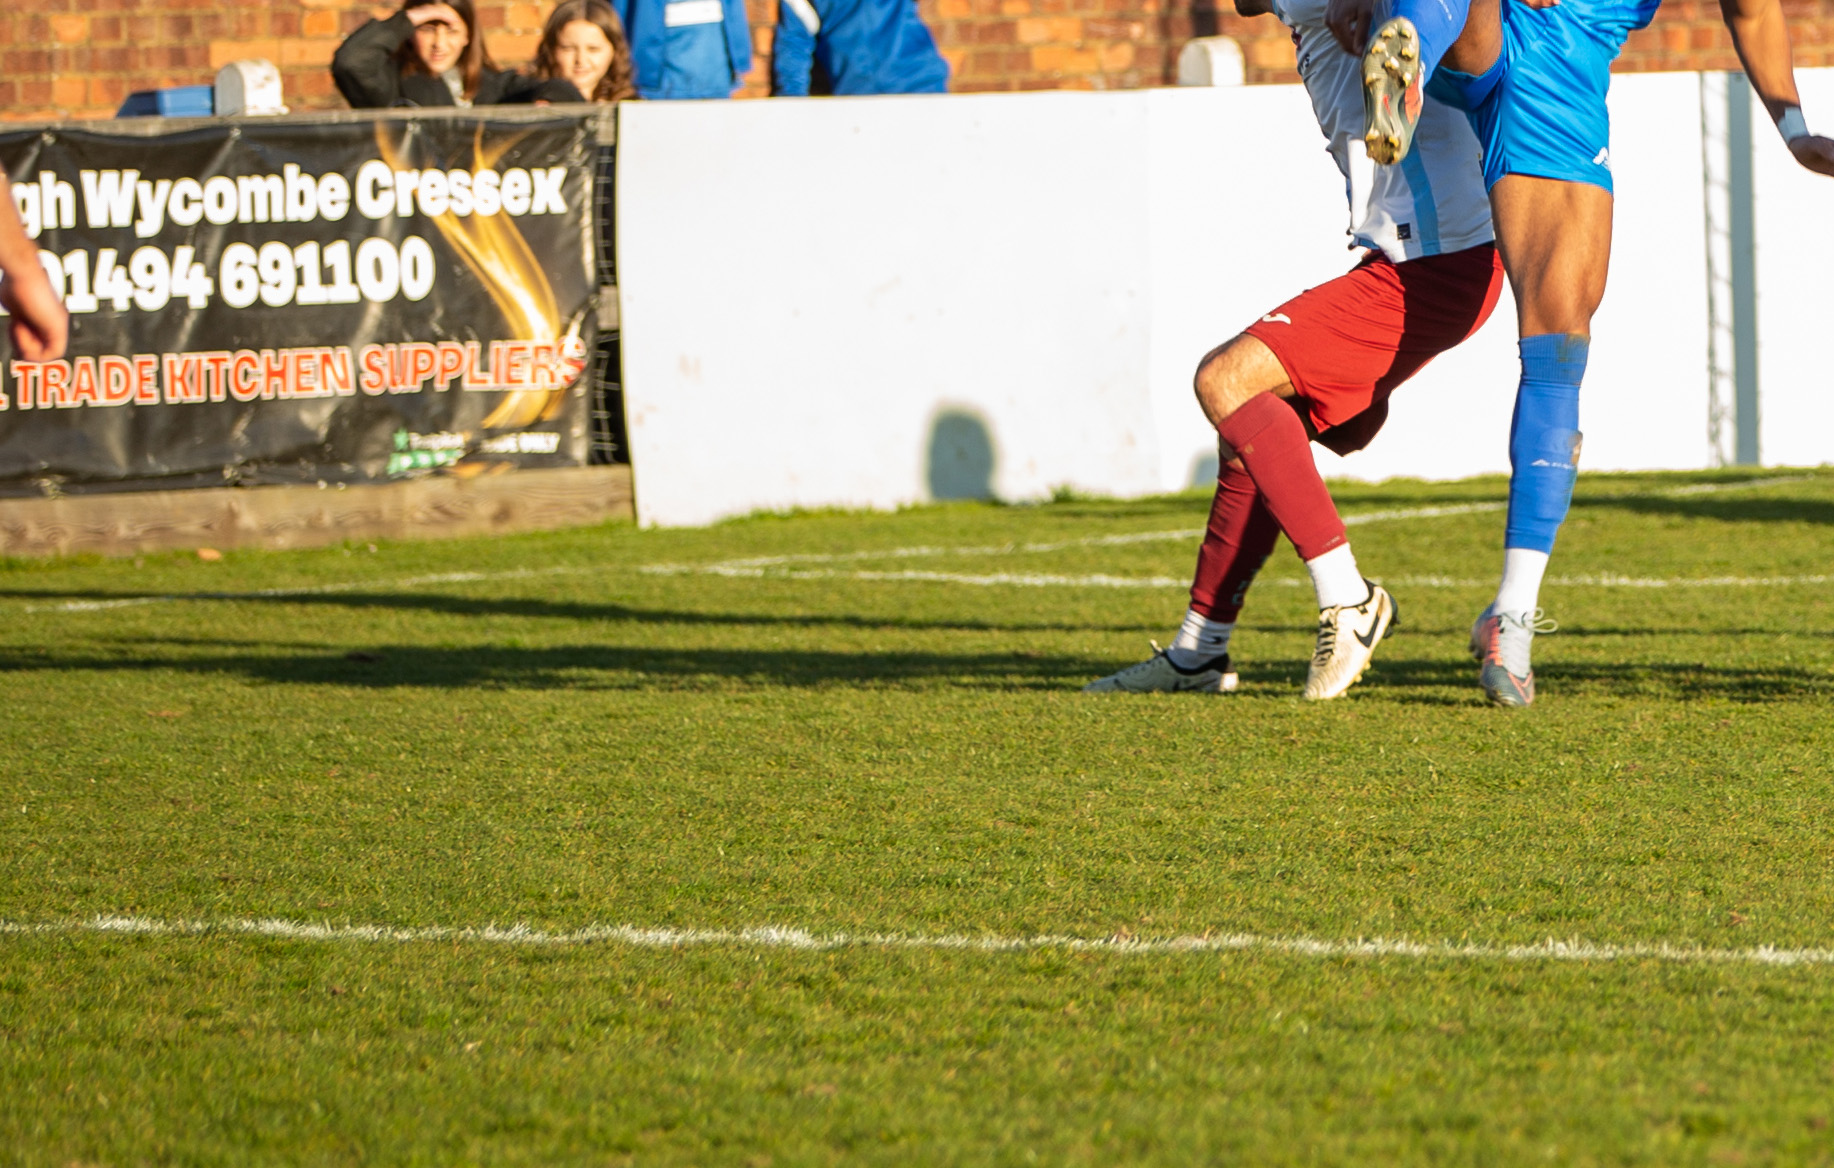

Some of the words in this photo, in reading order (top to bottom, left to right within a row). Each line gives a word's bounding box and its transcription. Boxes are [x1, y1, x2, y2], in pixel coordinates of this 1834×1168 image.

[11, 170, 76, 239] gh
[80, 163, 350, 238] Wycombe
[356, 159, 568, 220] Cressex
[219, 235, 435, 308] 691100
[10, 354, 160, 410] TRADE
[163, 346, 356, 404] KITCHEN
[359, 335, 587, 396] SUPPLIERS
